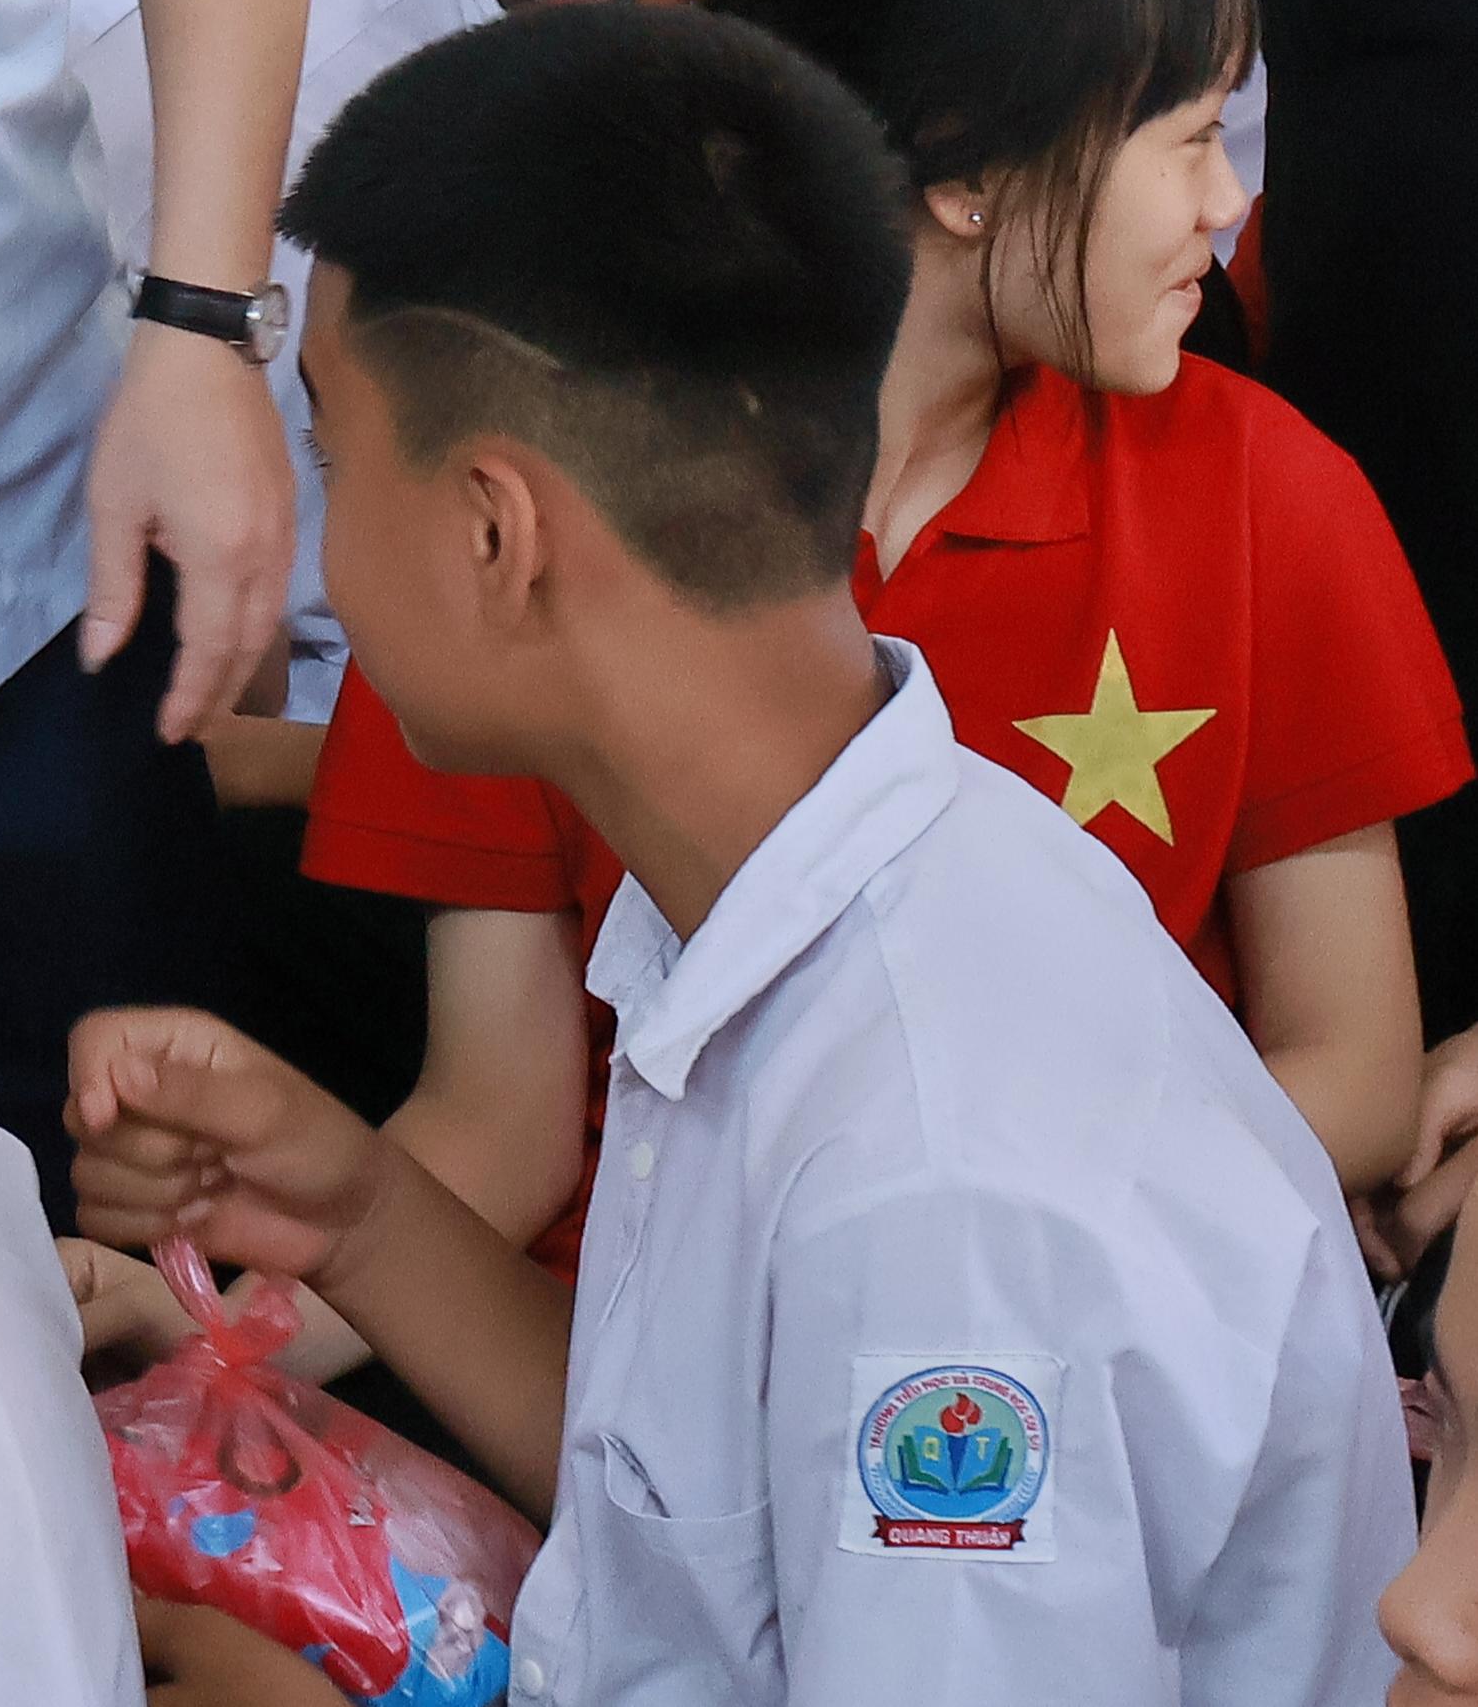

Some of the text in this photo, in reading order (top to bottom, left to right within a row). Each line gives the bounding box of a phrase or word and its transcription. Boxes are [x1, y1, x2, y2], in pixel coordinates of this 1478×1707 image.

[924, 1436, 991, 1462] Q T
[887, 1526, 951, 1546] QUANG
